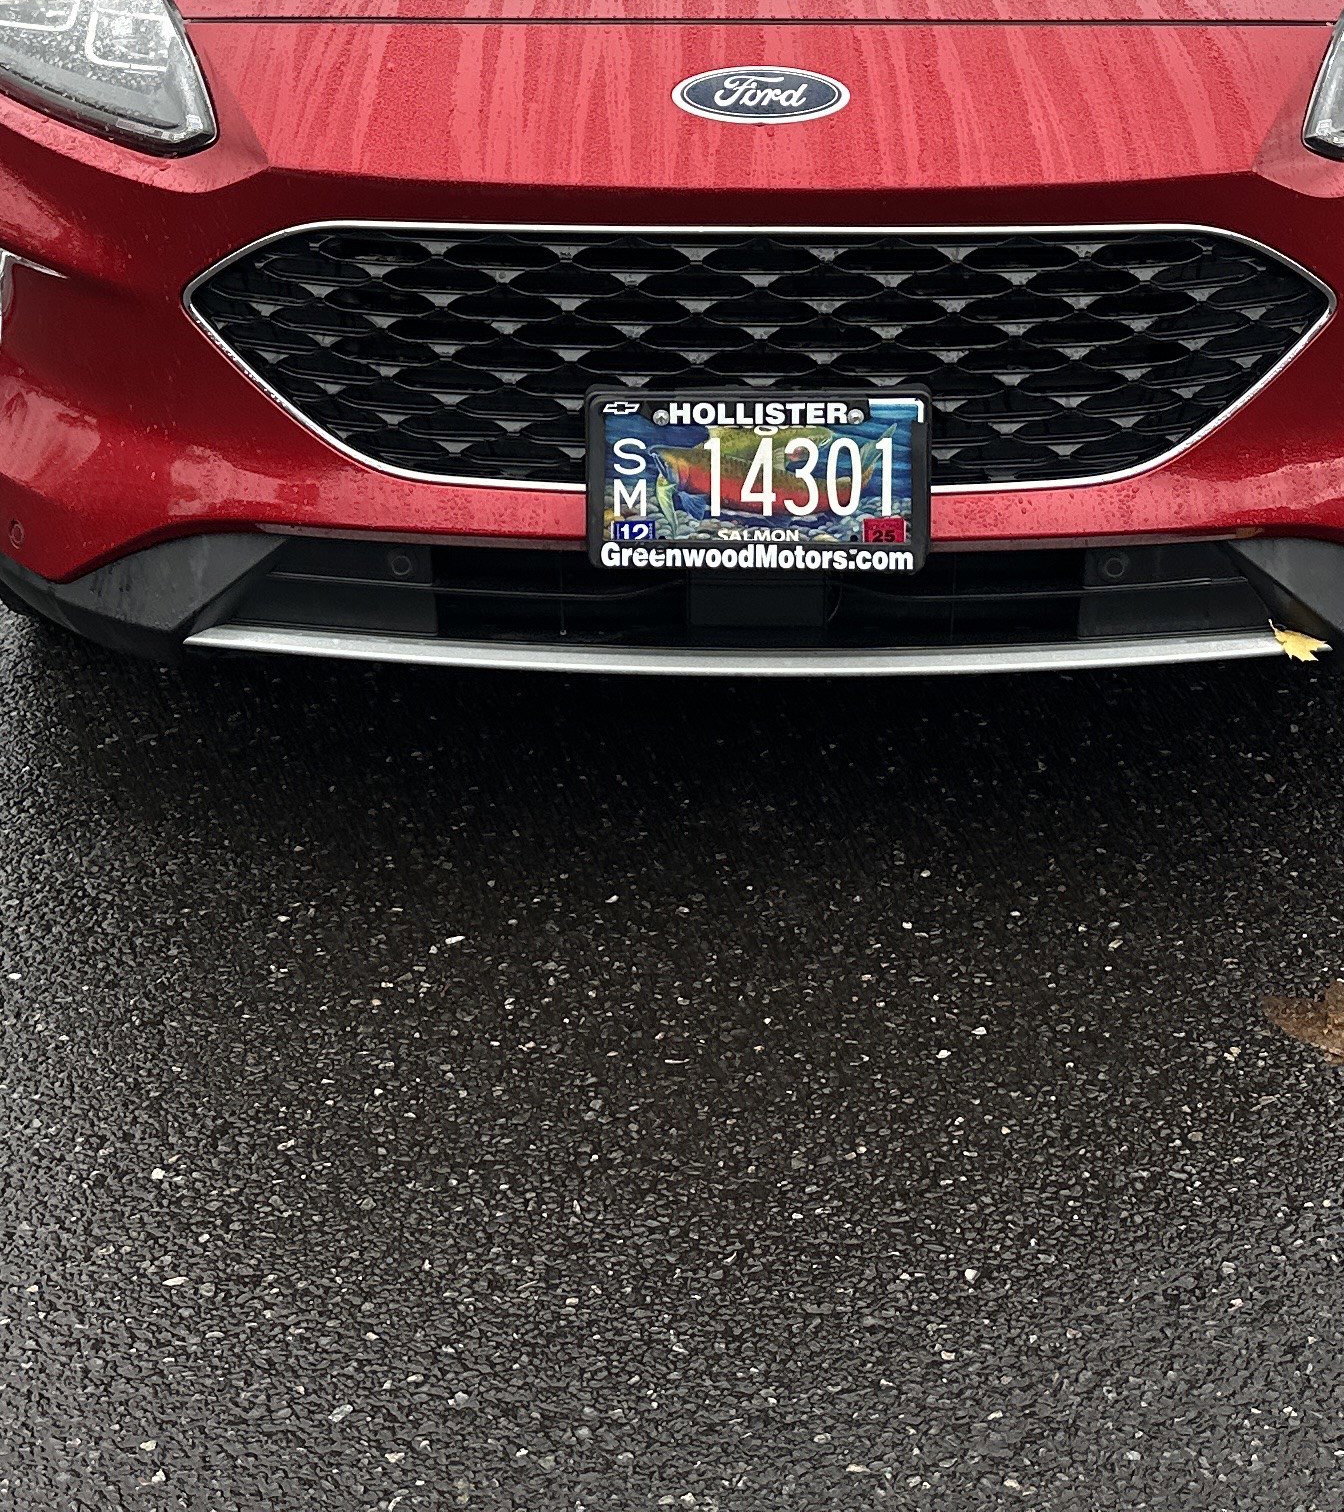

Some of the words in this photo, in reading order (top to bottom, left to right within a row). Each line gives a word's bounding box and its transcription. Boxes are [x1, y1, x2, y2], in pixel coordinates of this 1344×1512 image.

[714, 75, 808, 107] Ford
[669, 402, 848, 425] HOLLISTER
[703, 436, 894, 518] 14301
[619, 523, 650, 540] 12
[717, 528, 800, 542] SALMON
[871, 529, 896, 543] 25
[600, 541, 914, 571] GreenwoodMotors.com
